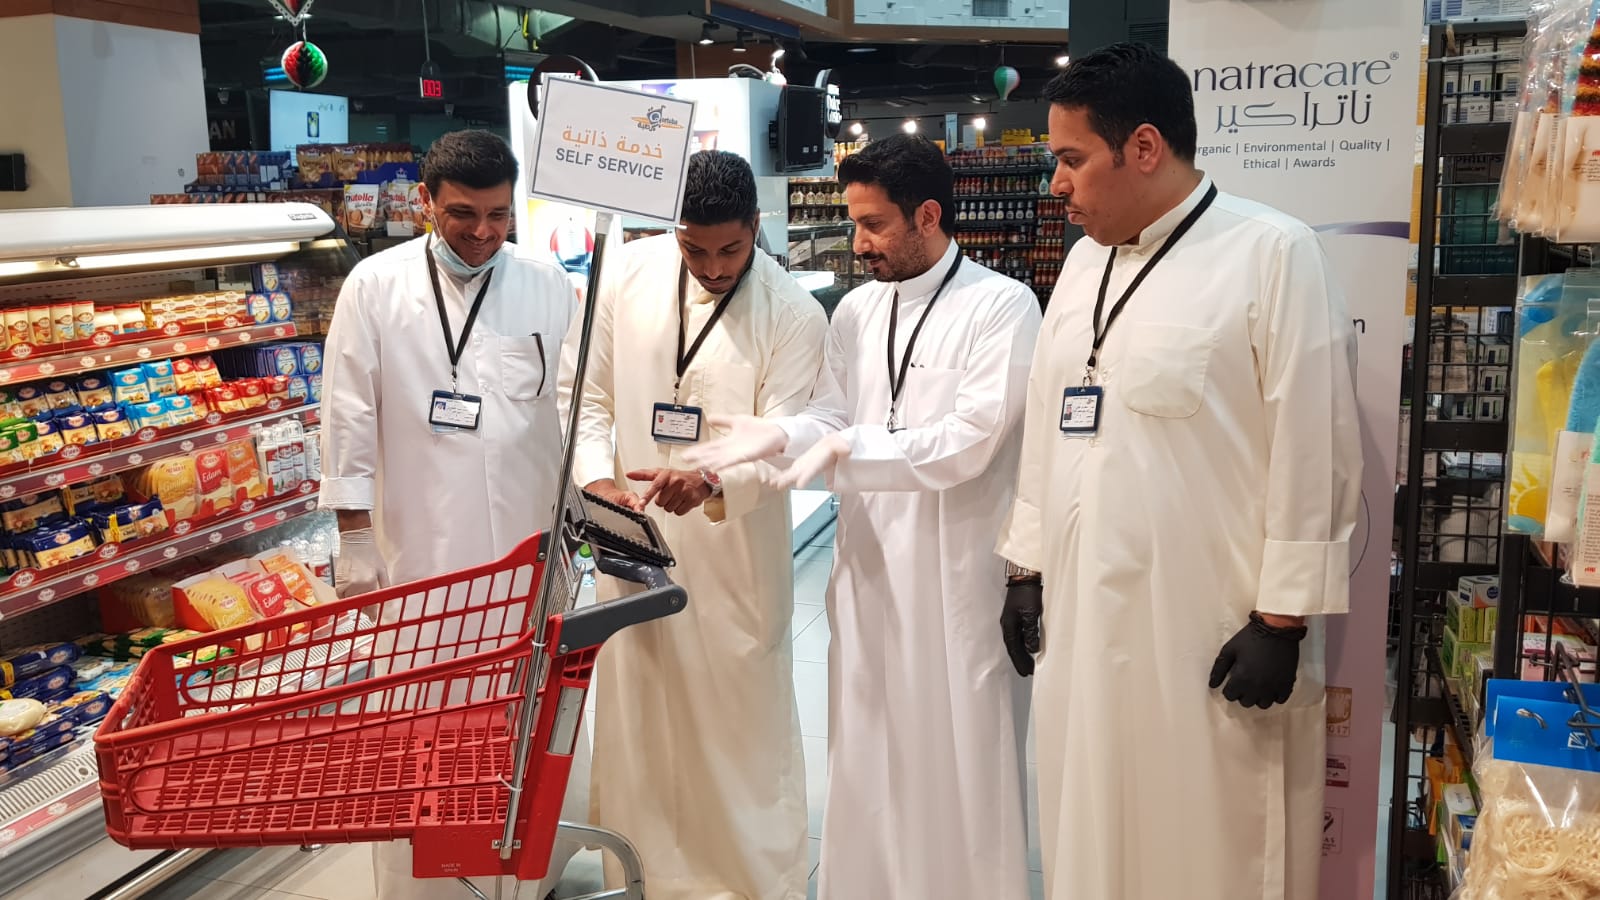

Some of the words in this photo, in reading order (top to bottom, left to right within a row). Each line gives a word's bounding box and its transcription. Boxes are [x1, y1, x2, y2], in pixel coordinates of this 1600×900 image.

[1214, 101, 1297, 133] كير
[1302, 89, 1372, 132] ناترا
[562, 125, 607, 148] ذاتية
[616, 135, 663, 159] خدمة
[1197, 143, 1232, 157] rganic
[1243, 140, 1327, 154] Environmental
[1339, 138, 1382, 152] Quality
[555, 147, 594, 166] SELF
[597, 156, 664, 181] SERVICE
[1243, 157, 1281, 170] Ethical
[1293, 156, 1336, 169] Awards
[345, 192, 374, 203] nutella
[201, 469, 223, 483] Edam
[262, 593, 283, 608] Edam
